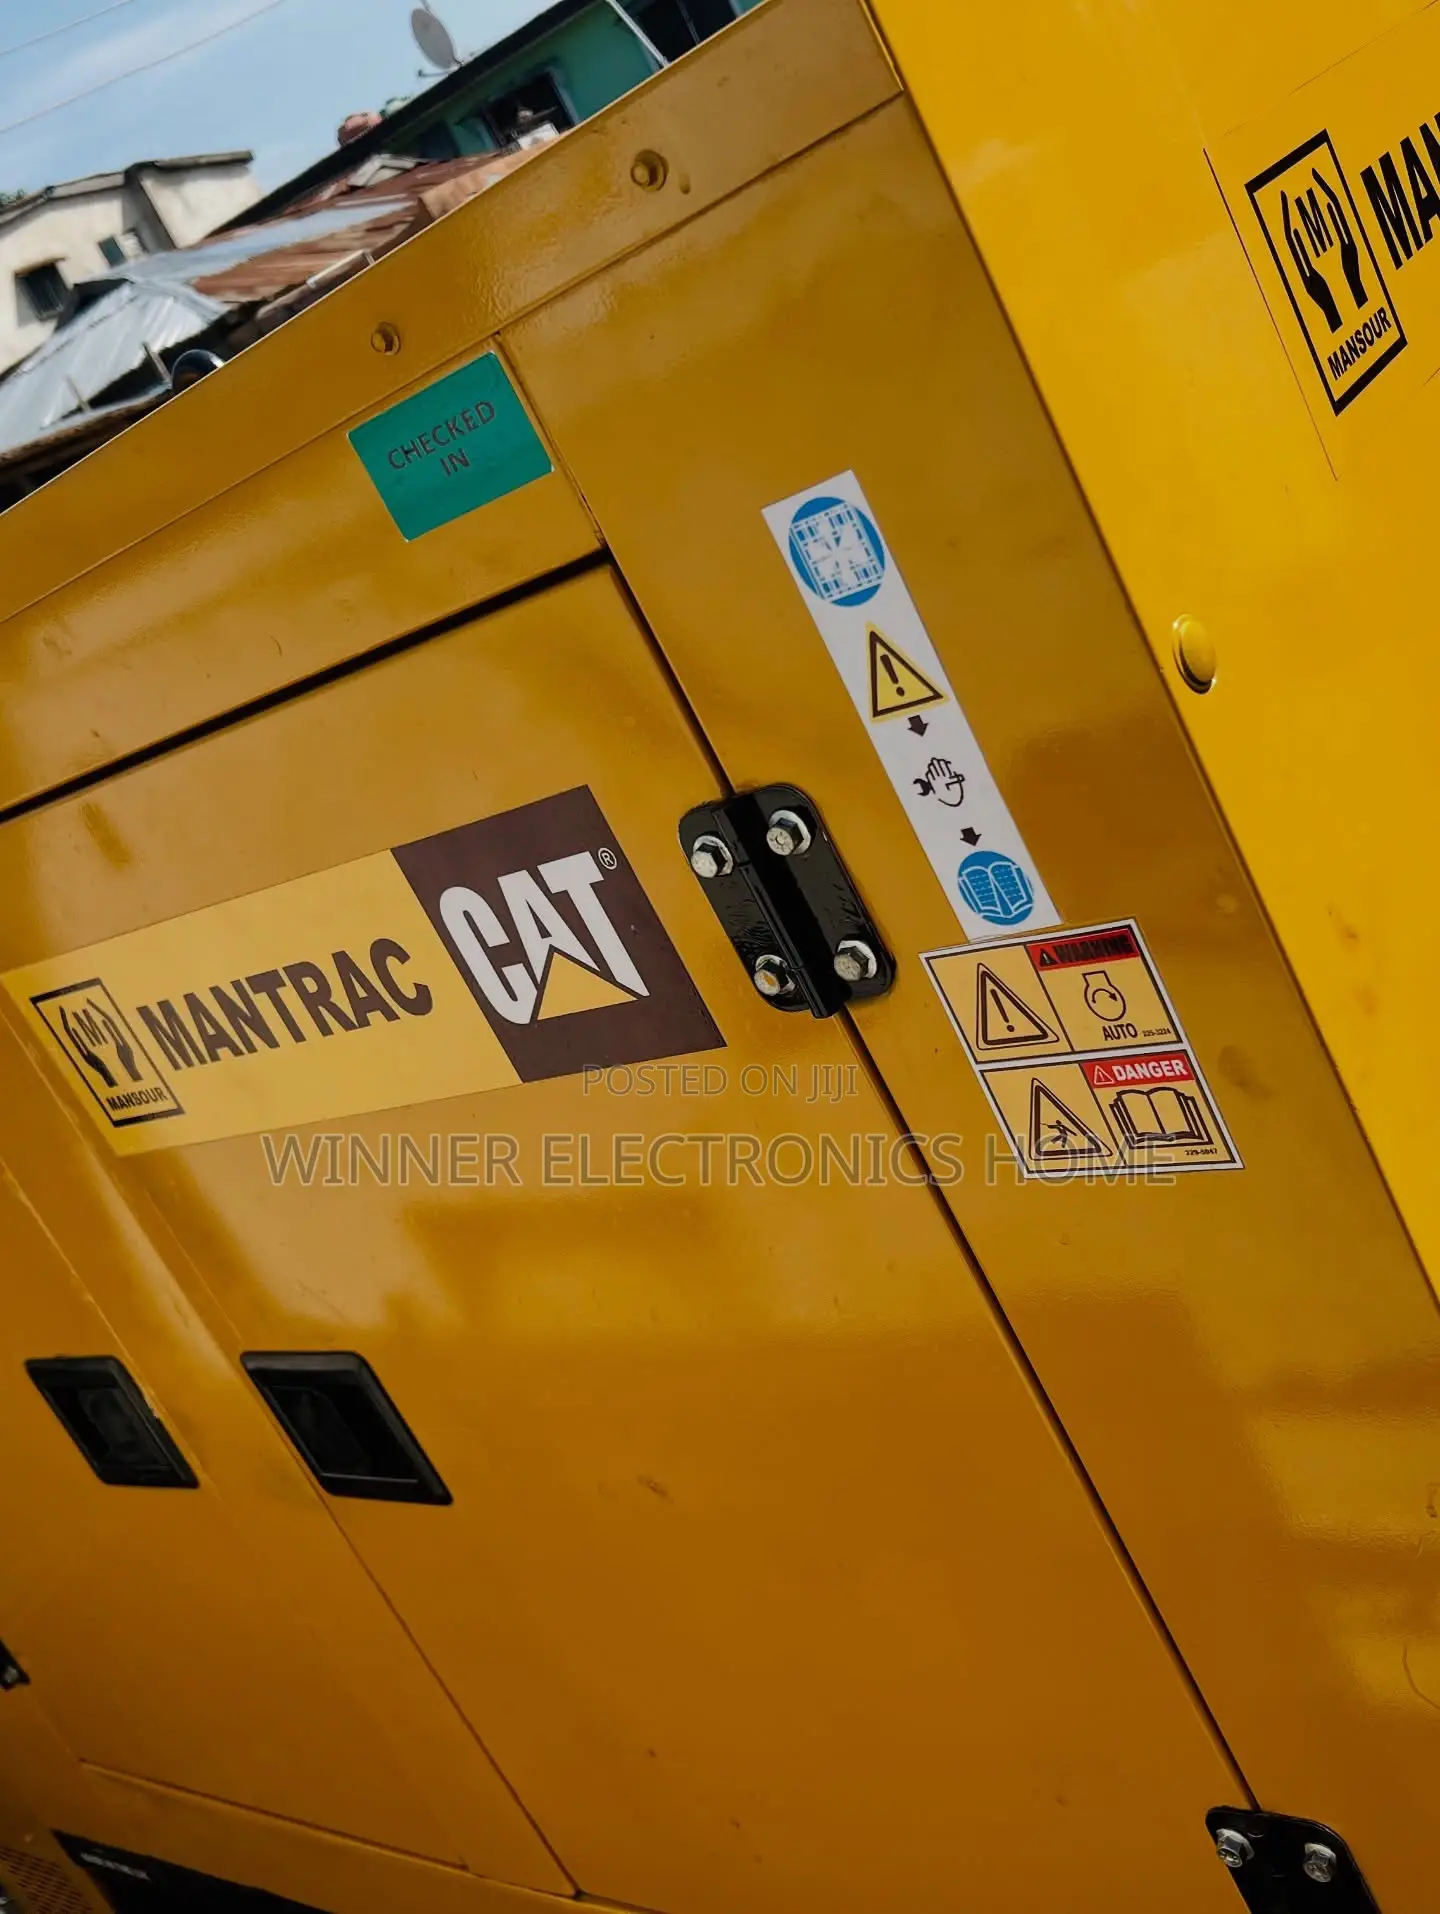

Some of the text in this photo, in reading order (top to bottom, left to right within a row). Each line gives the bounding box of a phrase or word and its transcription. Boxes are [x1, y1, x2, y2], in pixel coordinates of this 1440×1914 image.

[1327, 306, 1391, 381] MANSOUR
[388, 401, 495, 470] CHECKED
[440, 448, 470, 477] IN
[439, 851, 650, 1025] CAT
[136, 938, 434, 1071] MANTRAC
[1102, 1022, 1138, 1041] AUTO
[1111, 1059, 1188, 1082] DANGER
[106, 1087, 167, 1112] MANSOUR
